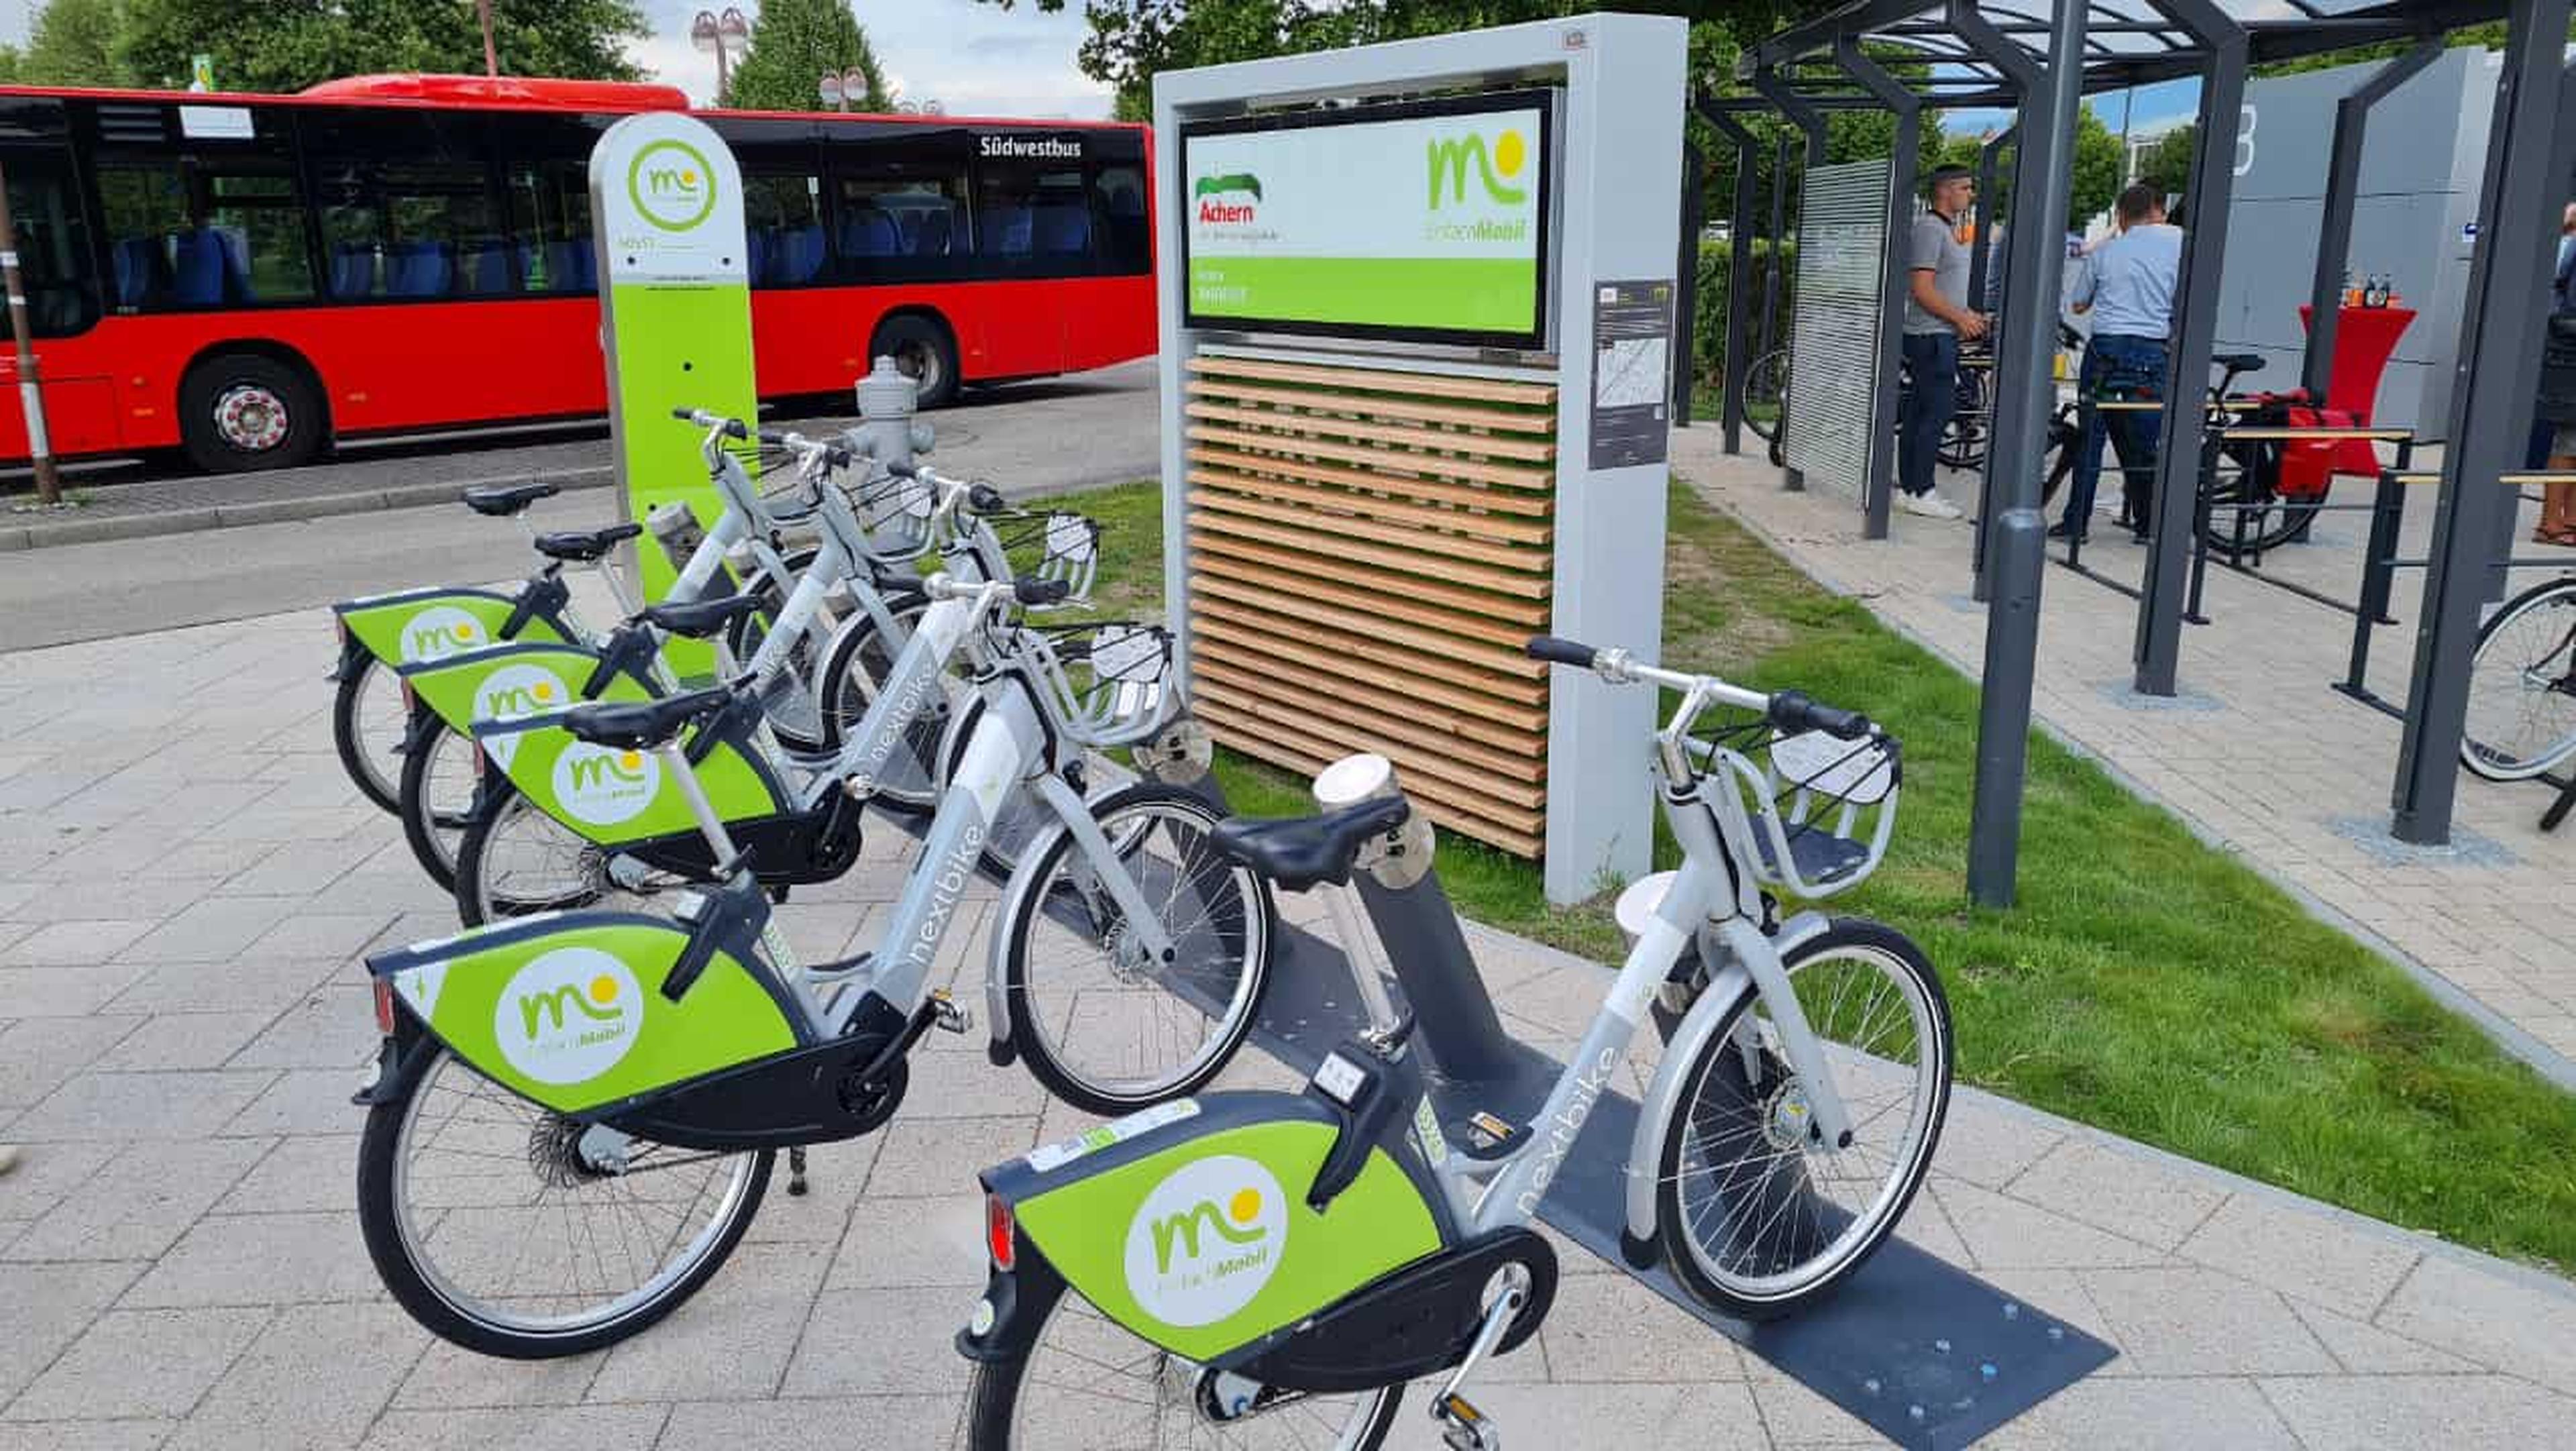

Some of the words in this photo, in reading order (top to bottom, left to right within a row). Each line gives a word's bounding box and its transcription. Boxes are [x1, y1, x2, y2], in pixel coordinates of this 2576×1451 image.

[981, 136, 1081, 157] Südwestbus
[1199, 200, 1253, 223] Achern
[870, 661, 932, 761] nextbike
[909, 824, 984, 963] nextbike
[1516, 1047, 1615, 1216] nextbike
